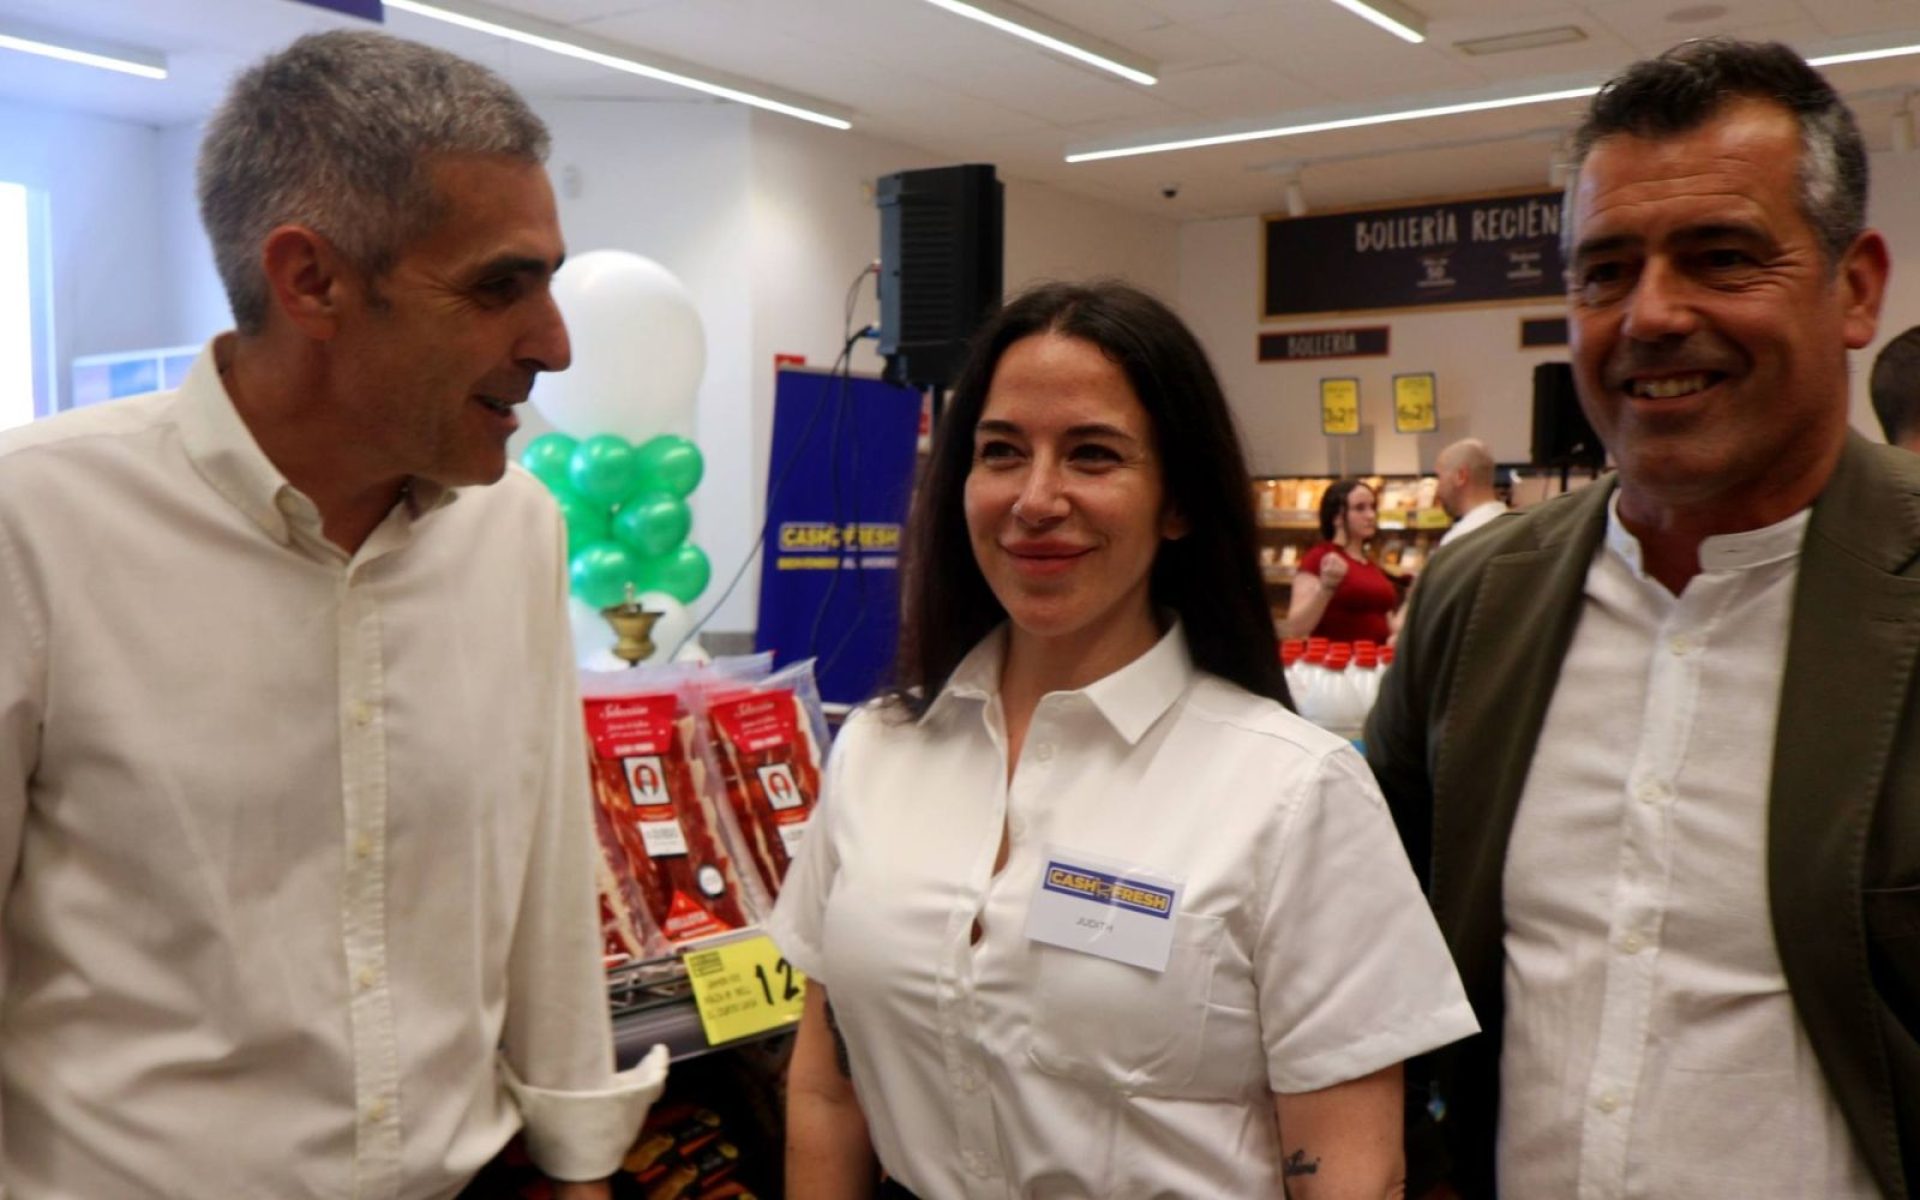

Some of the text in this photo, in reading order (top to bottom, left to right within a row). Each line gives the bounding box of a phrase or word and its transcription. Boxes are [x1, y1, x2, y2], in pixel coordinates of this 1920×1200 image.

[1355, 201, 1559, 252] BOLLERÍA RECIÉN
[1288, 332, 1357, 357] BOLLERÍA
[1051, 870, 1167, 910] CASH FRESH
